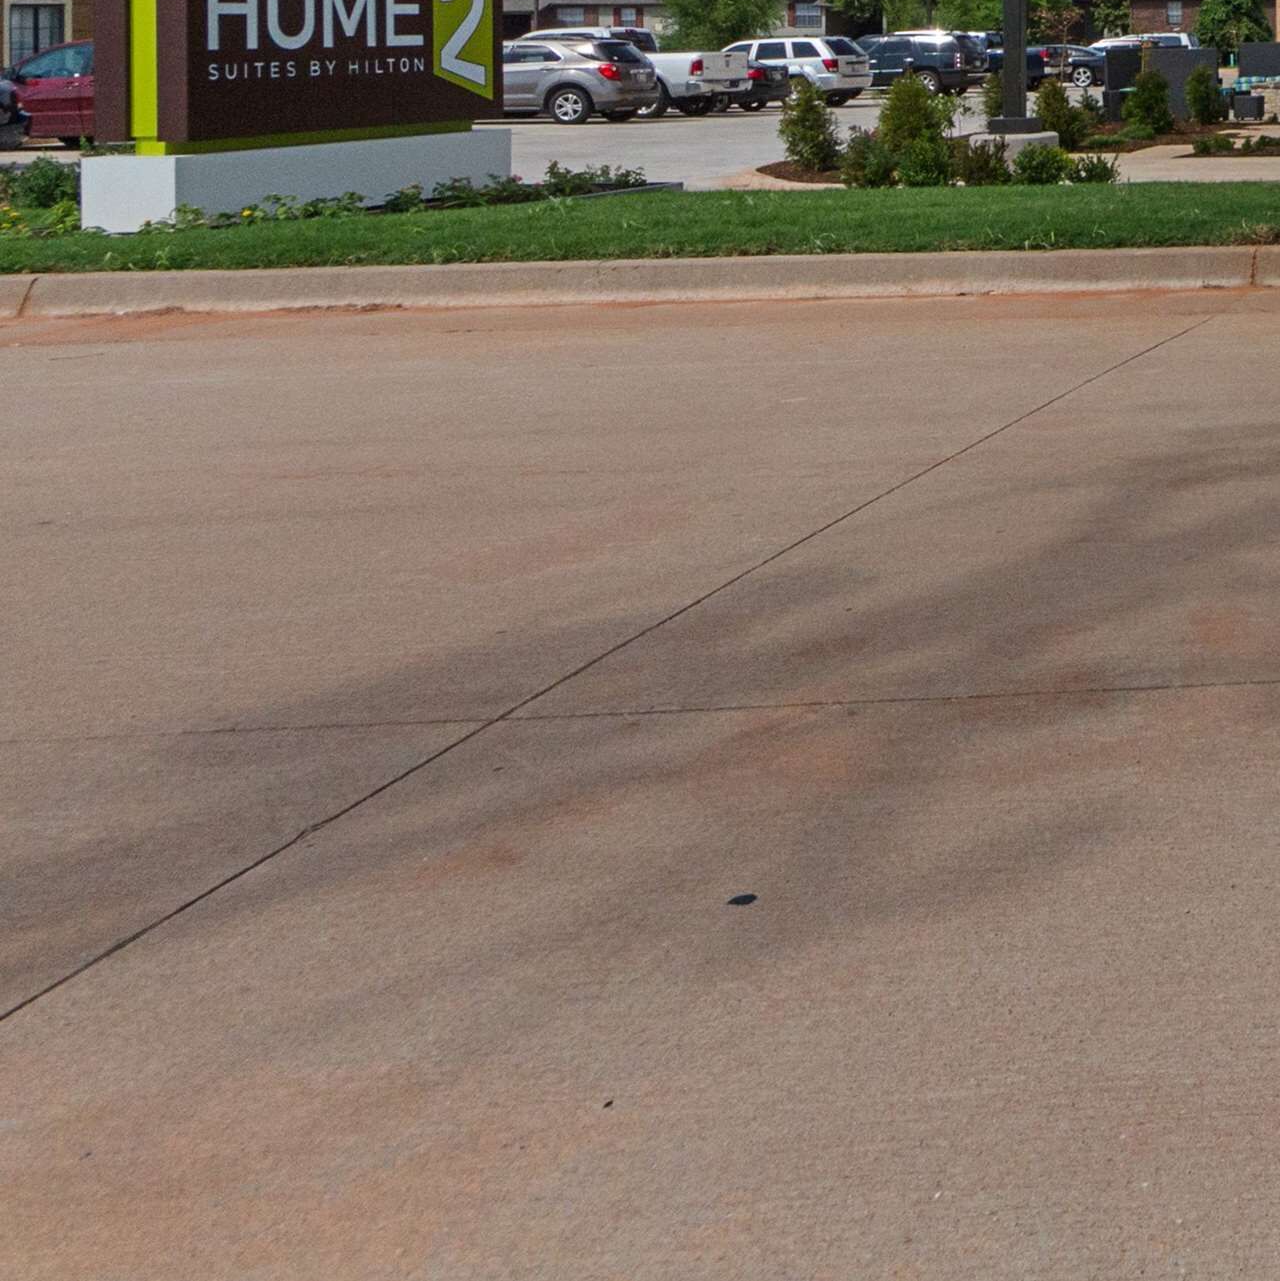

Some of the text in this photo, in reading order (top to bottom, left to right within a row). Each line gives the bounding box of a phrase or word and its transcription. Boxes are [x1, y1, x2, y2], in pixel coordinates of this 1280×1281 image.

[208, 57, 425, 81] SUITES BY HILTON
